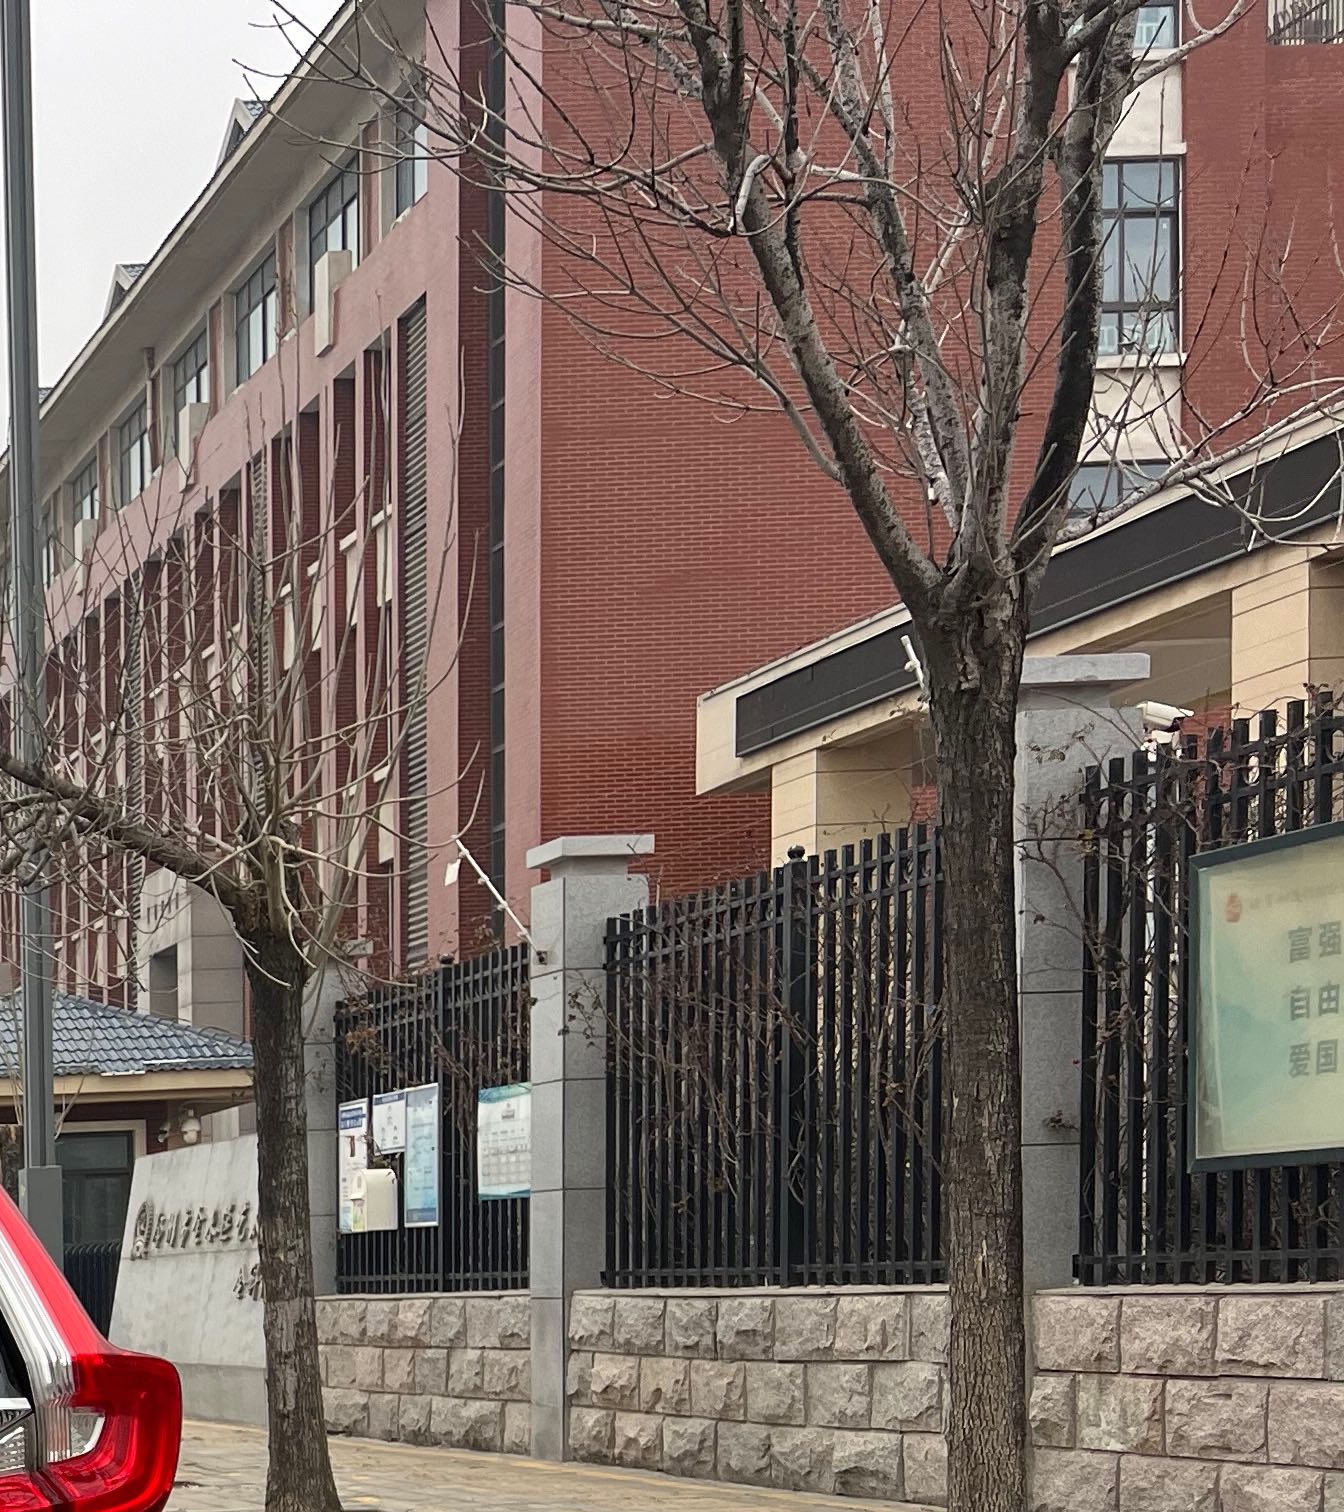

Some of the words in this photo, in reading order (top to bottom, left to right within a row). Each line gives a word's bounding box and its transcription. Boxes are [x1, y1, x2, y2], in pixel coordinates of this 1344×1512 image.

[1288, 920, 1343, 963] 富强
[1289, 981, 1341, 1021] 自由
[1287, 1038, 1339, 1079] 爱国
